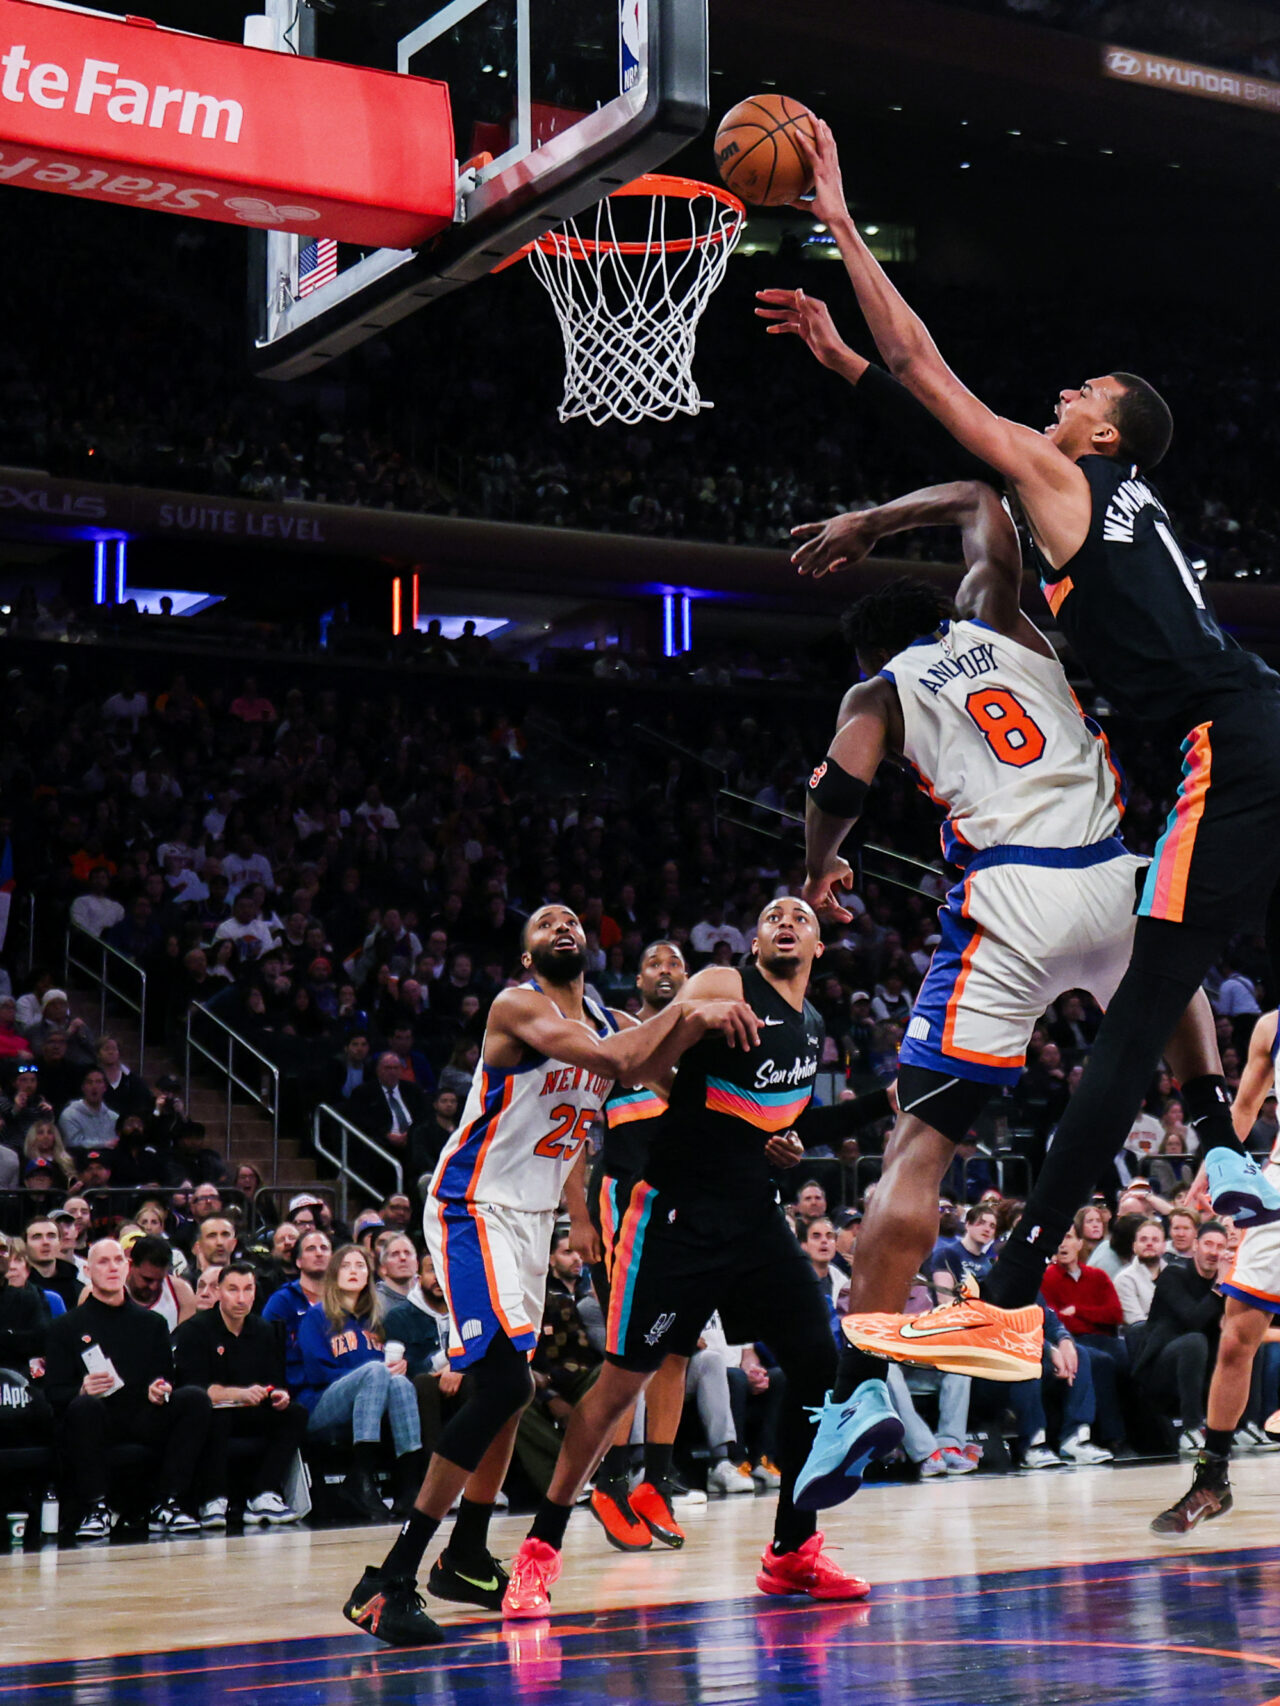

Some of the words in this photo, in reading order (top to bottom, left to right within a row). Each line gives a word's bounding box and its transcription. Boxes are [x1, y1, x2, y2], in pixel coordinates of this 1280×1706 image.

[1145, 60, 1240, 96] HYUNDAI
[0, 486, 107, 519] XUS
[159, 504, 237, 534] SUITE
[246, 513, 326, 543] LEVEL
[965, 687, 1047, 769] 8
[754, 1058, 787, 1089] San
[787, 1054, 818, 1086] Antoni
[533, 1102, 598, 1162] 25
[331, 1330, 358, 1358] NEW
